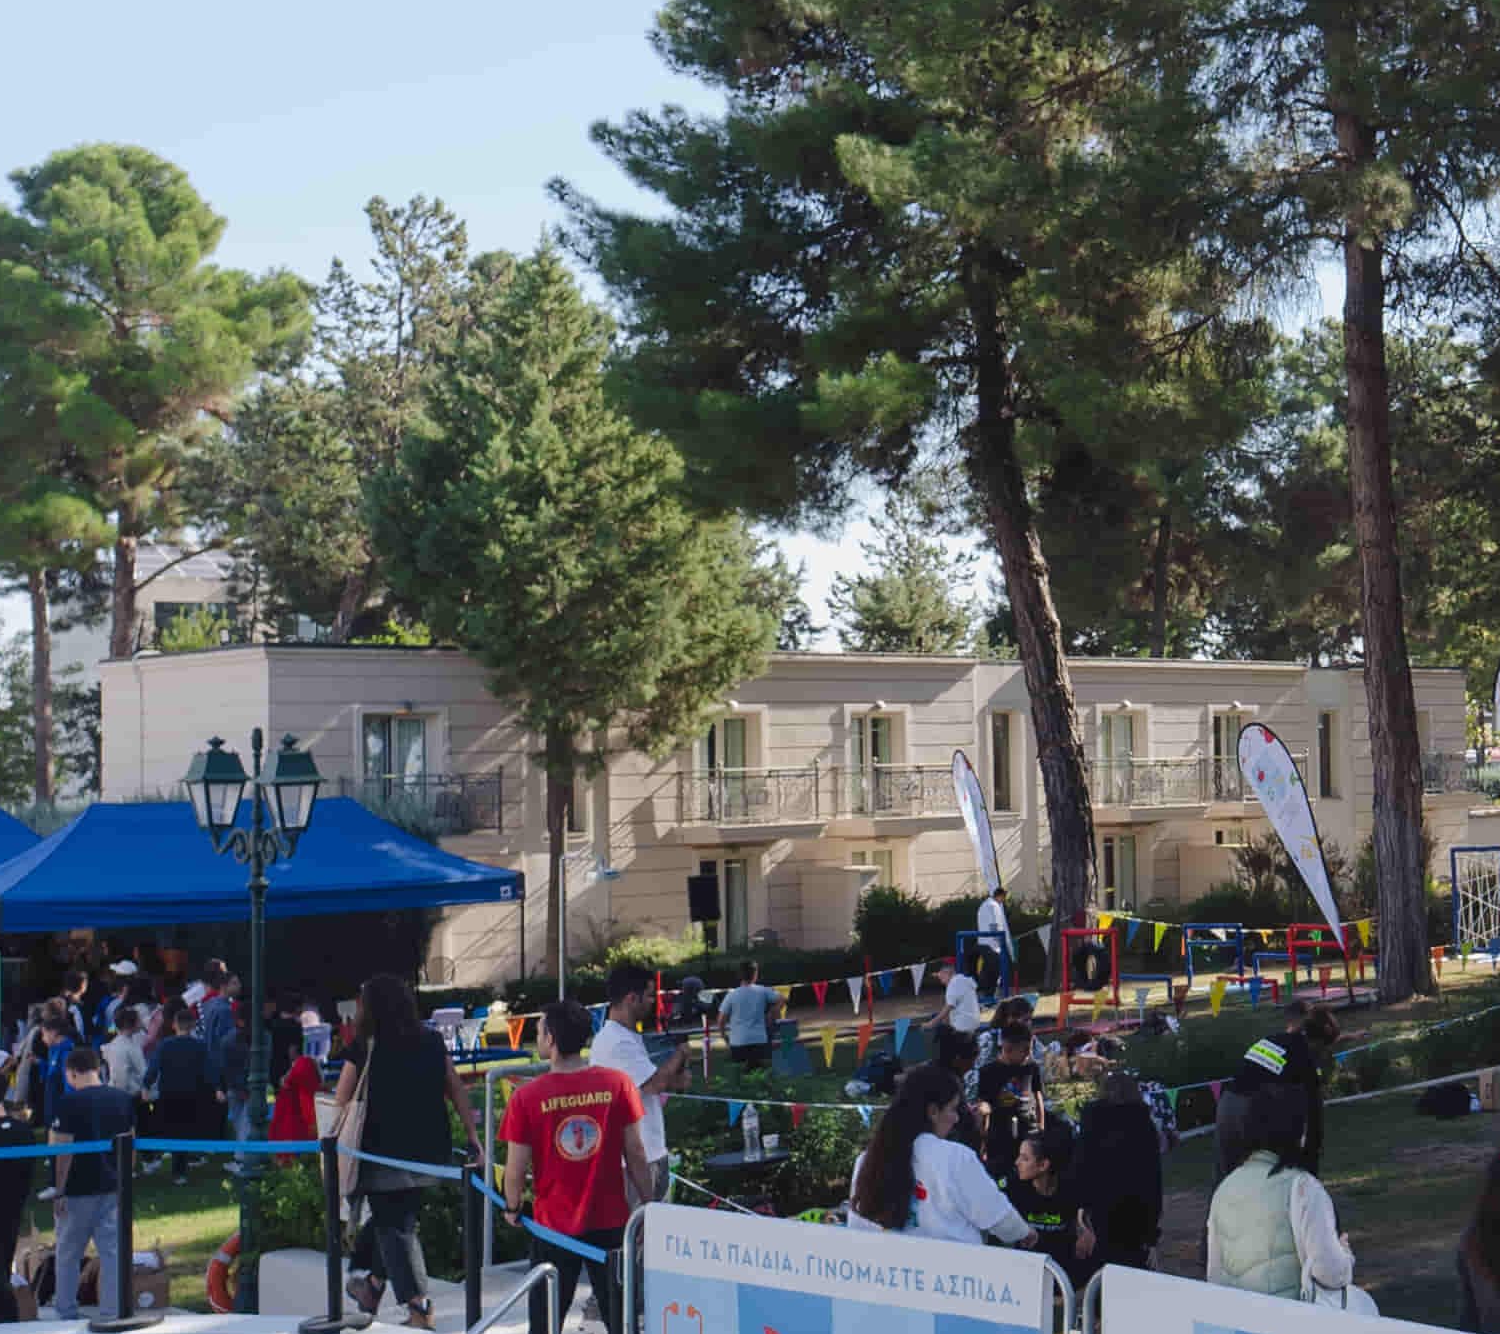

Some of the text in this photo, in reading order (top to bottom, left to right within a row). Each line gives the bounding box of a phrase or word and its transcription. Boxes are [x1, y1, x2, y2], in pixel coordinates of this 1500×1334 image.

[540, 1091, 613, 1113] LIFEGUARD
[665, 1234, 693, 1260] ΓΙΑ
[699, 1240, 723, 1262] ΤΑ
[805, 1253, 926, 1293] ΓΙΝΟΜΑΣΤΕ
[932, 1272, 1022, 1307] ΑΣΠΙΔΑ.
